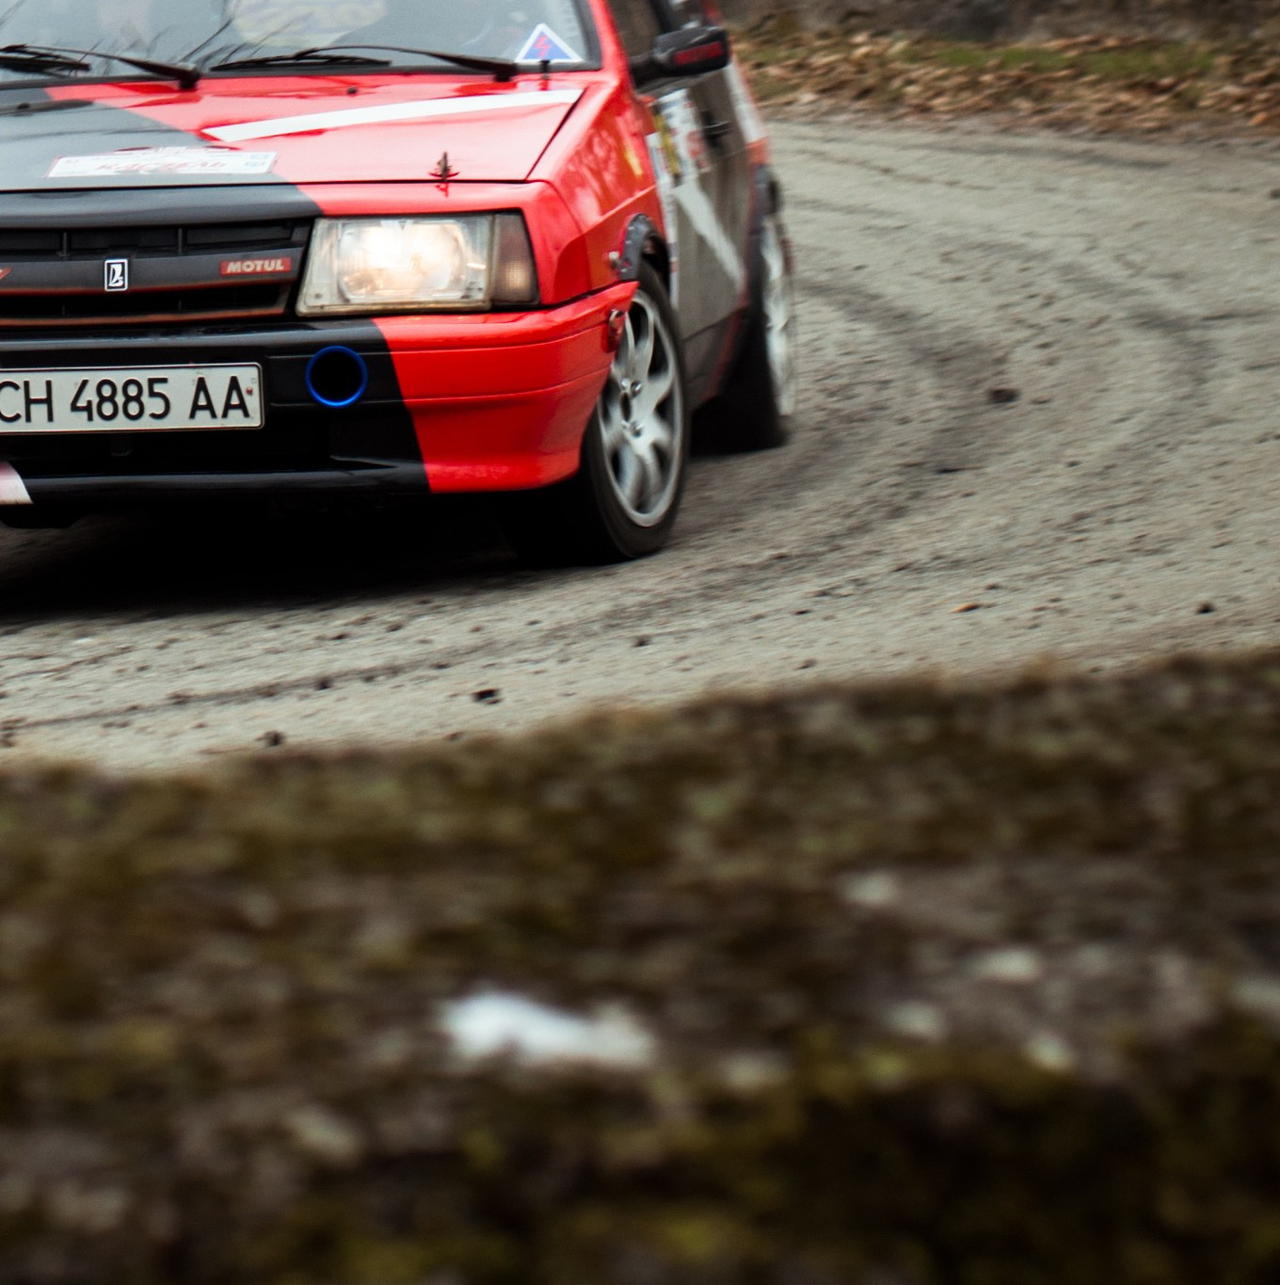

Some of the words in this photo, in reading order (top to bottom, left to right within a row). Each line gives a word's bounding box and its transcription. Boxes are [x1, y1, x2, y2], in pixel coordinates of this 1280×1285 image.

[226, 259, 285, 273] MOTUL
[70, 377, 171, 422] 4885
[188, 375, 251, 420] AA
